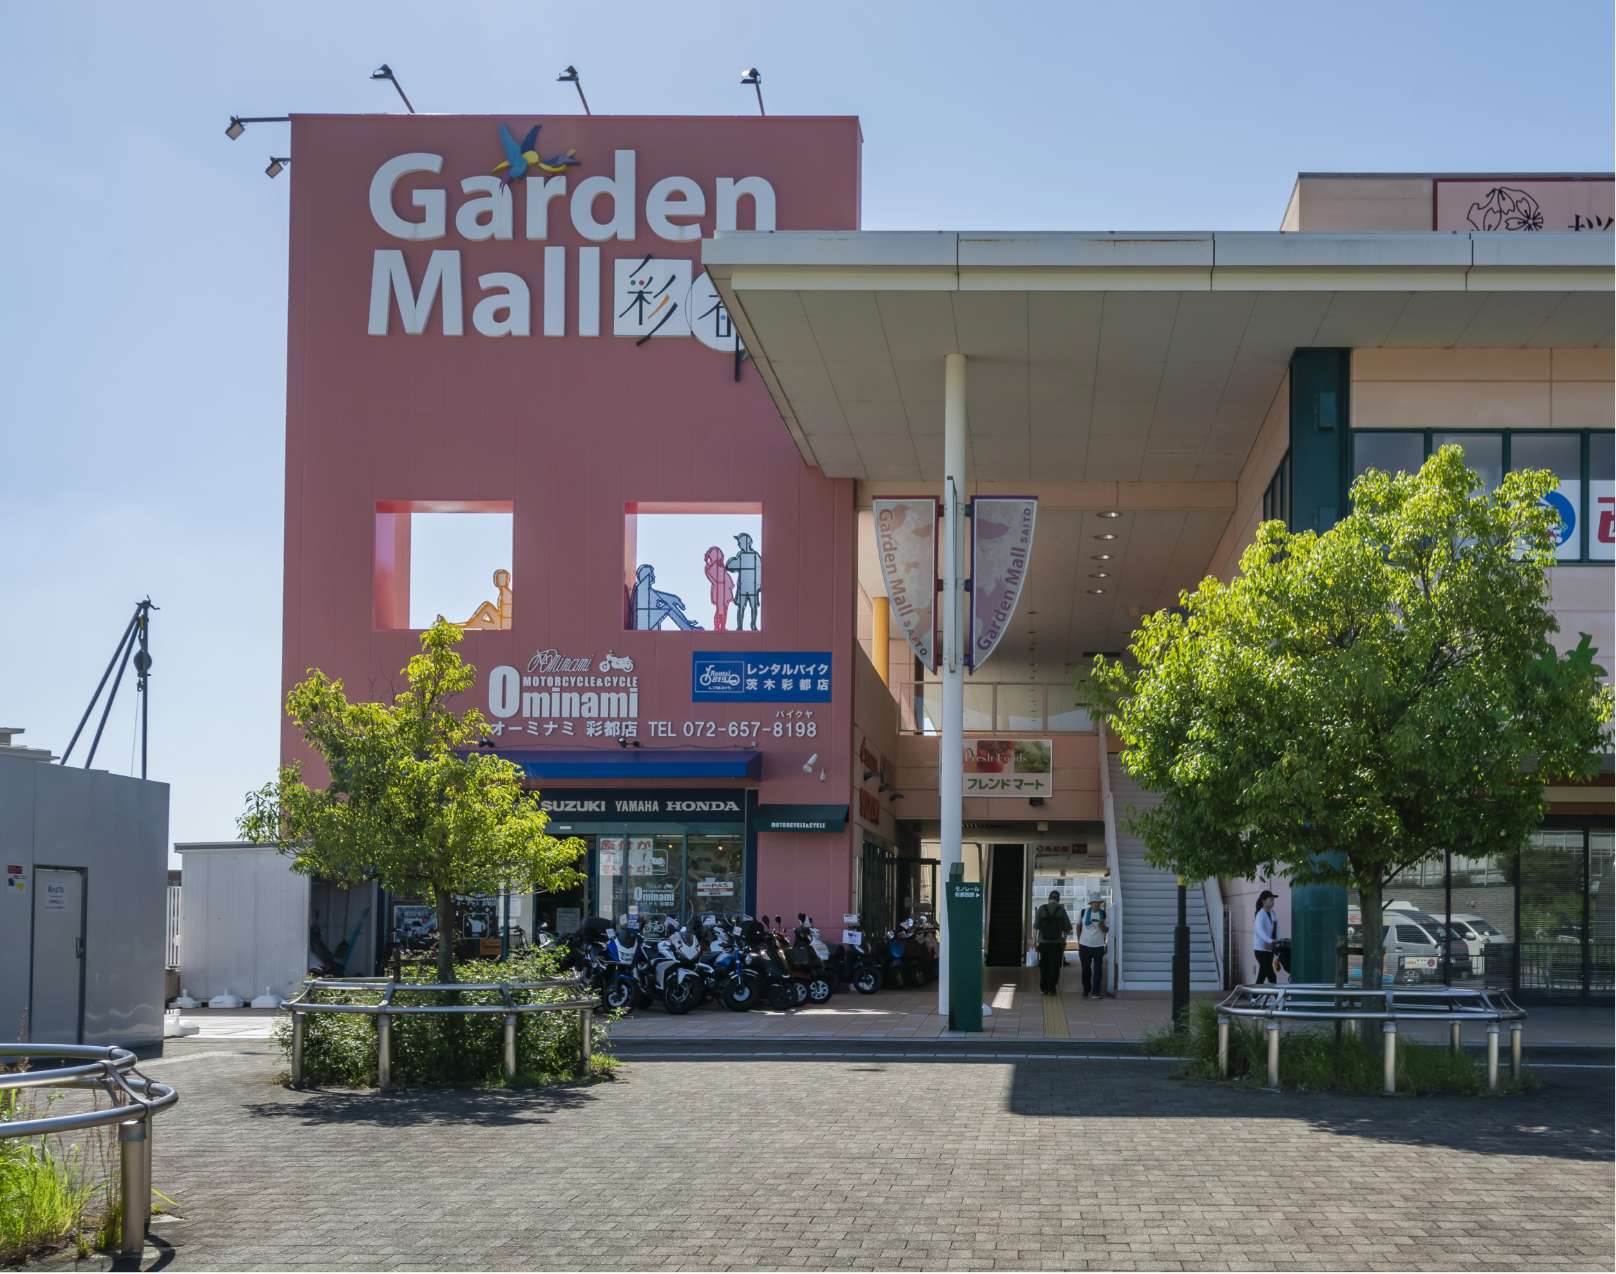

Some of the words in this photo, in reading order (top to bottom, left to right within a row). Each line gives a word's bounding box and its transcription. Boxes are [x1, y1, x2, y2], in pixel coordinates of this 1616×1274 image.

[369, 149, 777, 242] Garden
[367, 245, 600, 338] Mall
[879, 509, 898, 574] Garden
[890, 578, 914, 617] Mall
[903, 620, 928, 656] SAITO
[977, 589, 1015, 650] Garden
[1004, 547, 1025, 586] Mall
[1020, 508, 1032, 544] SAITO
[746, 664, 829, 676] レンタルバイク
[522, 676, 638, 688] MOTORCYCLE&CYCLE
[746, 679, 830, 691] 茨木彩都店
[488, 665, 638, 719] Ominami
[776, 710, 813, 719] バイクヤ
[490, 721, 574, 736] オーミナミ
[586, 720, 638, 737] 彩都店
[648, 721, 677, 737] TEL
[683, 721, 817, 738] 072-657-8198
[967, 777, 1045, 791] フレンドマート
[541, 800, 607, 813] SUZUKI
[615, 800, 660, 813] YAMAHA
[666, 800, 741, 812] HONDA
